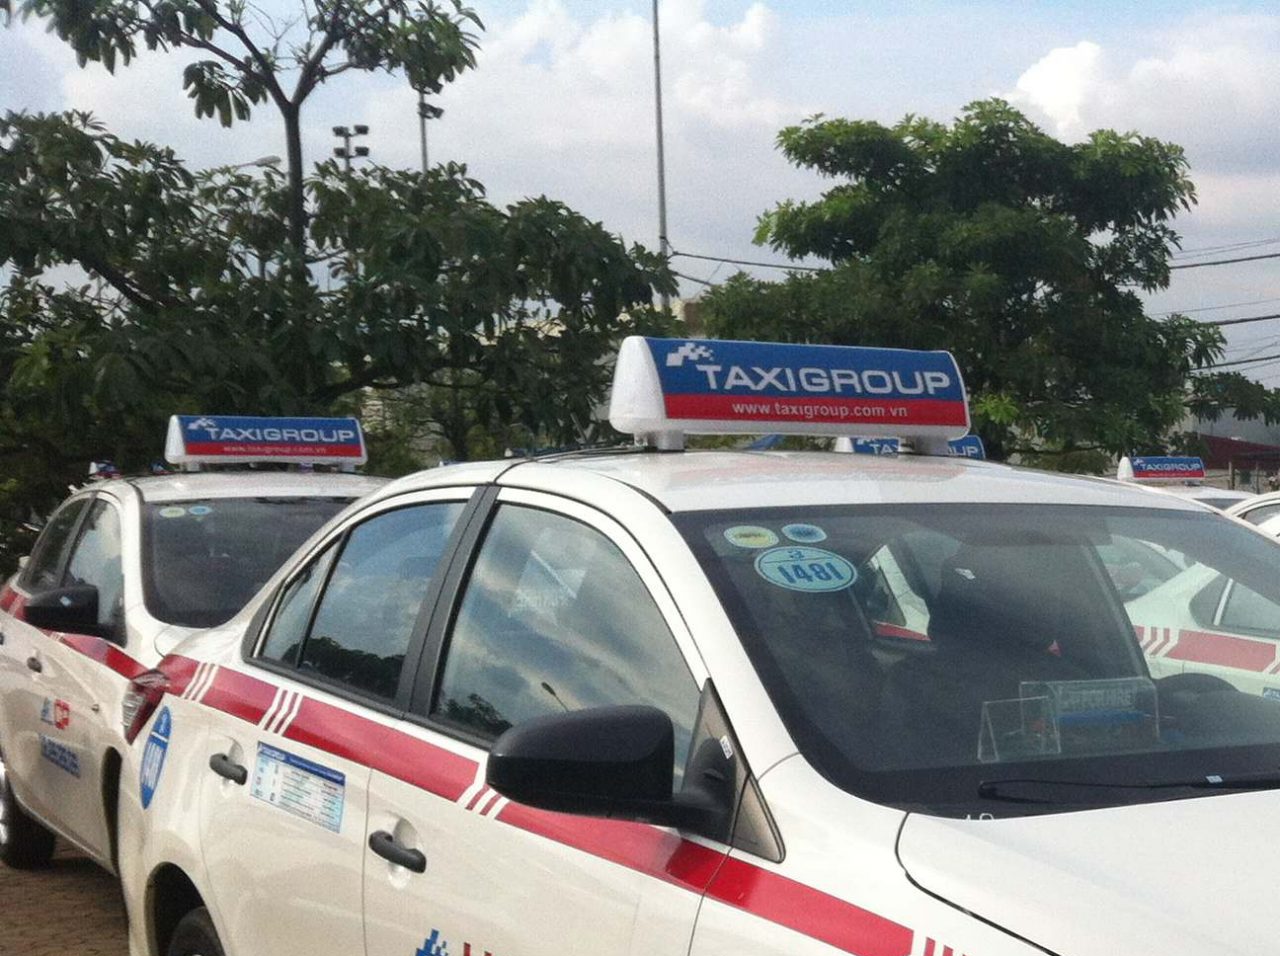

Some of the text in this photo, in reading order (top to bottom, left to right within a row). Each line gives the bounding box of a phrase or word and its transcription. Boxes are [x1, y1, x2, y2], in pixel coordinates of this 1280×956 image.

[696, 363, 951, 396] TAXIGROUP
[205, 428, 355, 443] TAXIGROUP
[777, 562, 844, 584] 1481
